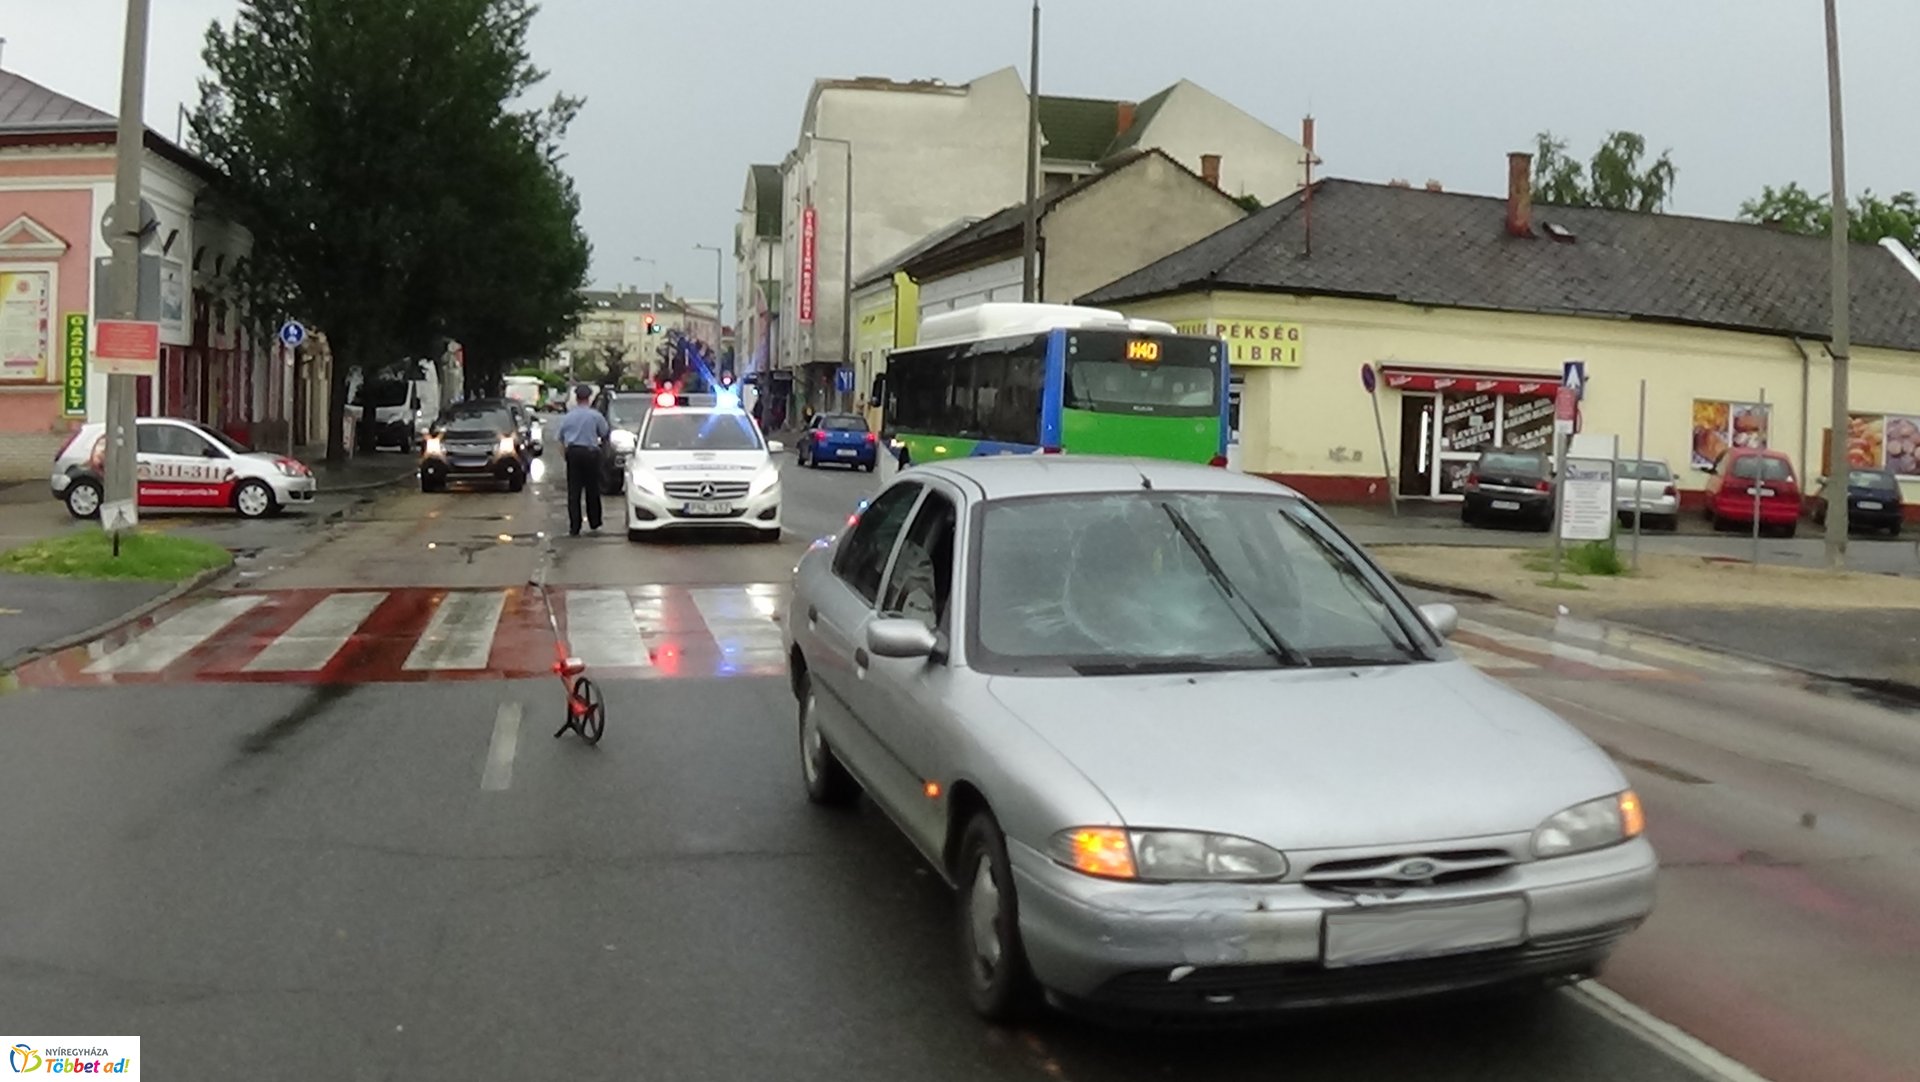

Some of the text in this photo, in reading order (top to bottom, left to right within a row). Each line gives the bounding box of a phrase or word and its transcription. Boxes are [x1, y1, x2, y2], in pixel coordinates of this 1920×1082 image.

[1216, 322, 1299, 341] PÉKSÉG
[1129, 341, 1158, 359] H40
[1237, 345, 1296, 362] IBRI
[69, 316, 84, 408] GAZDABOLT
[154, 464, 219, 479] 311-311
